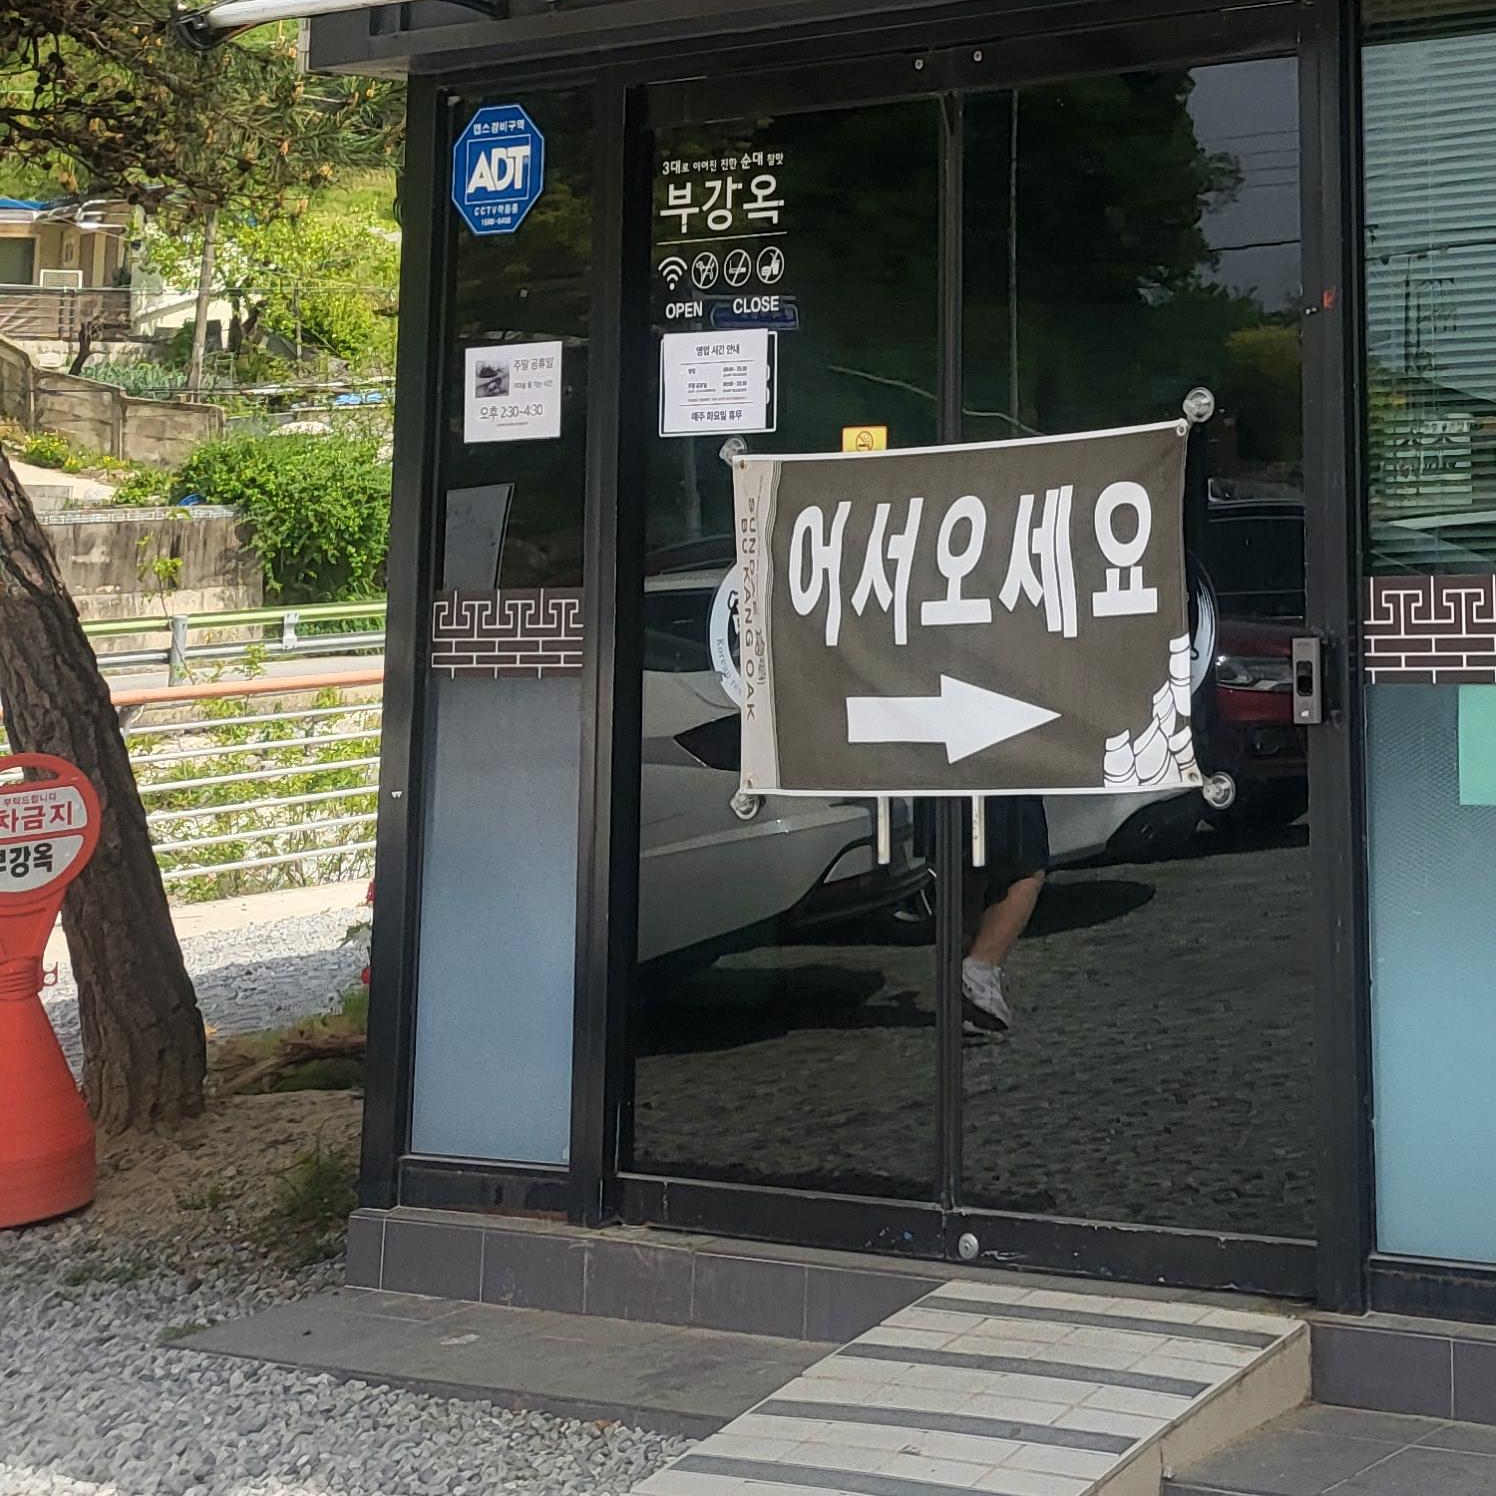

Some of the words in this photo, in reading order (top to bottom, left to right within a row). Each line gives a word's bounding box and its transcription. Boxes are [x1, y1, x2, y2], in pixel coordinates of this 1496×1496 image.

[466, 144, 531, 195] ADT
[662, 159, 690, 176] 3대로
[692, 159, 717, 173] 이어진
[720, 157, 737, 172] 진한
[740, 151, 764, 170] 순대
[766, 152, 784, 167] 참맛
[659, 173, 785, 234] 부강옥
[665, 300, 703, 319] OPEN
[732, 295, 780, 314] CLOSE
[513, 359, 530, 372] 주말
[531, 356, 554, 371] 공휴일
[479, 405, 499, 421] 오후
[788, 480, 1158, 647] 어서오세요
[743, 566, 755, 648] KANG
[745, 658, 756, 721] OAK
